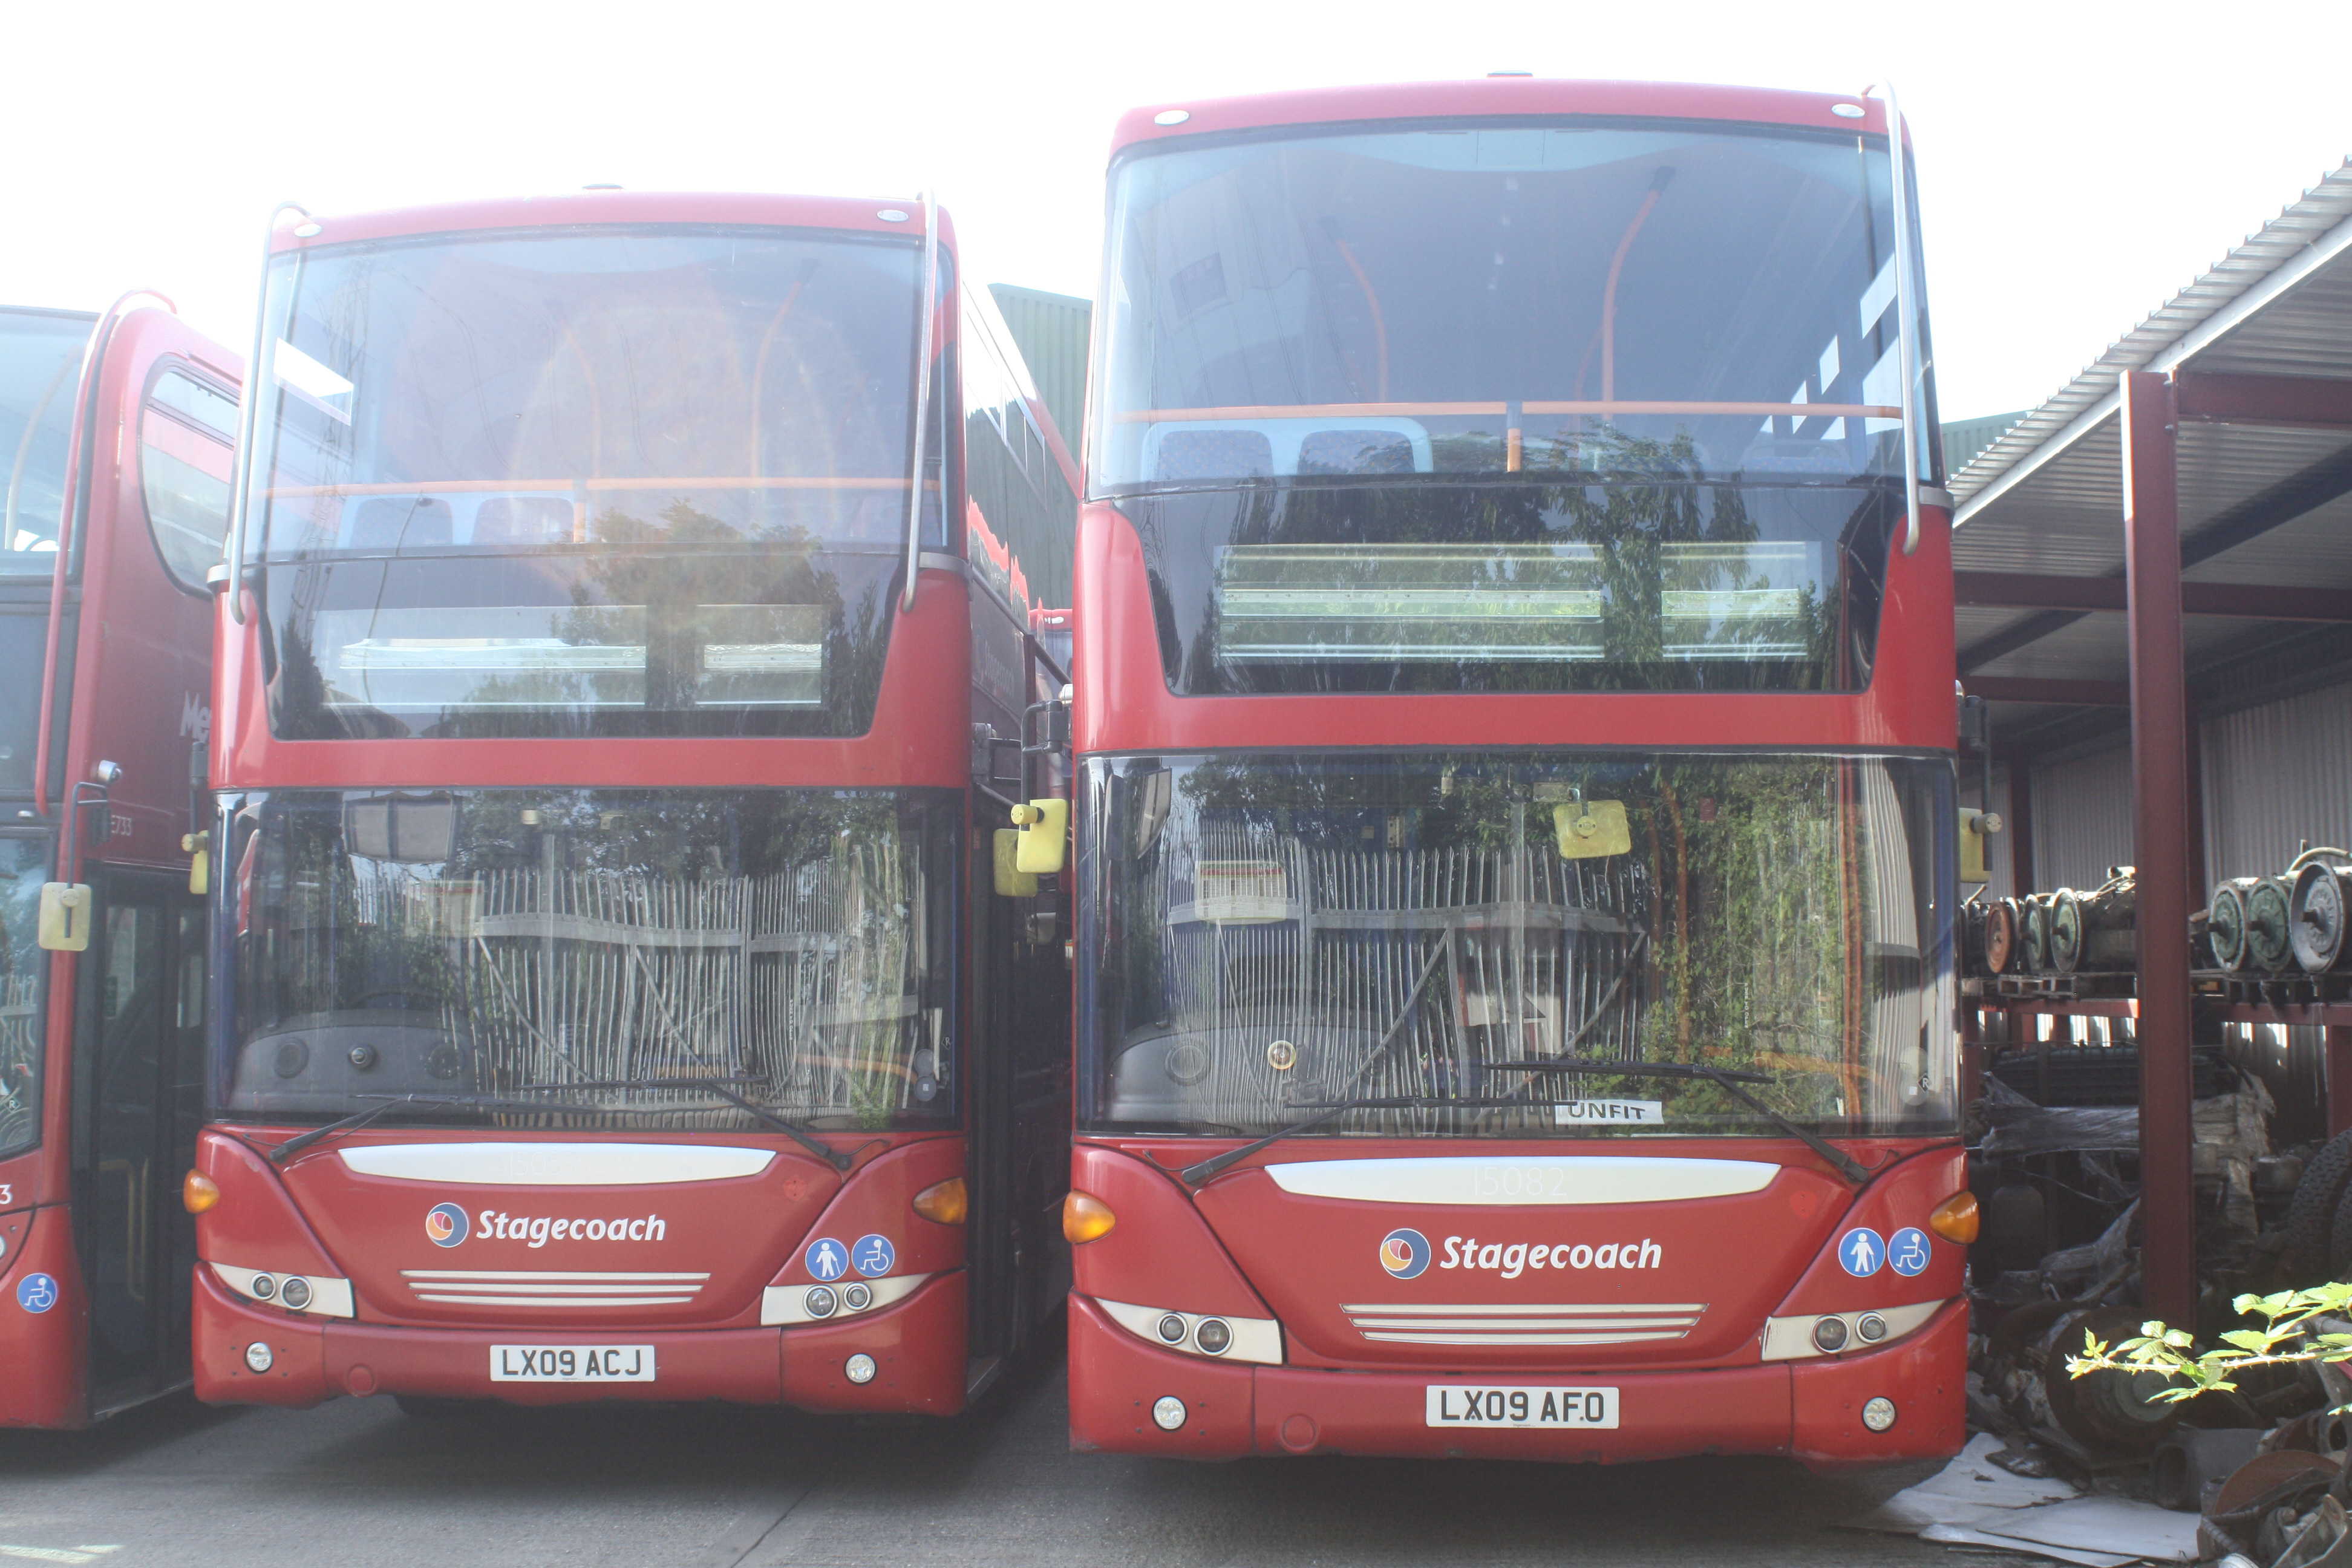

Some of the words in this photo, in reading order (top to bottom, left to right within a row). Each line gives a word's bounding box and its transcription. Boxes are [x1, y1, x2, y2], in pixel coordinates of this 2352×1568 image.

[1568, 1102, 1646, 1120] UNFIT
[1474, 1166, 1567, 1195] 15082
[476, 1210, 665, 1248] Stagecoach
[1440, 1236, 1662, 1279] Stagecoach
[502, 1349, 575, 1376] LX09
[585, 1349, 641, 1376] ACJ
[1441, 1390, 1529, 1422] LX09
[1540, 1391, 1604, 1422] AFO
